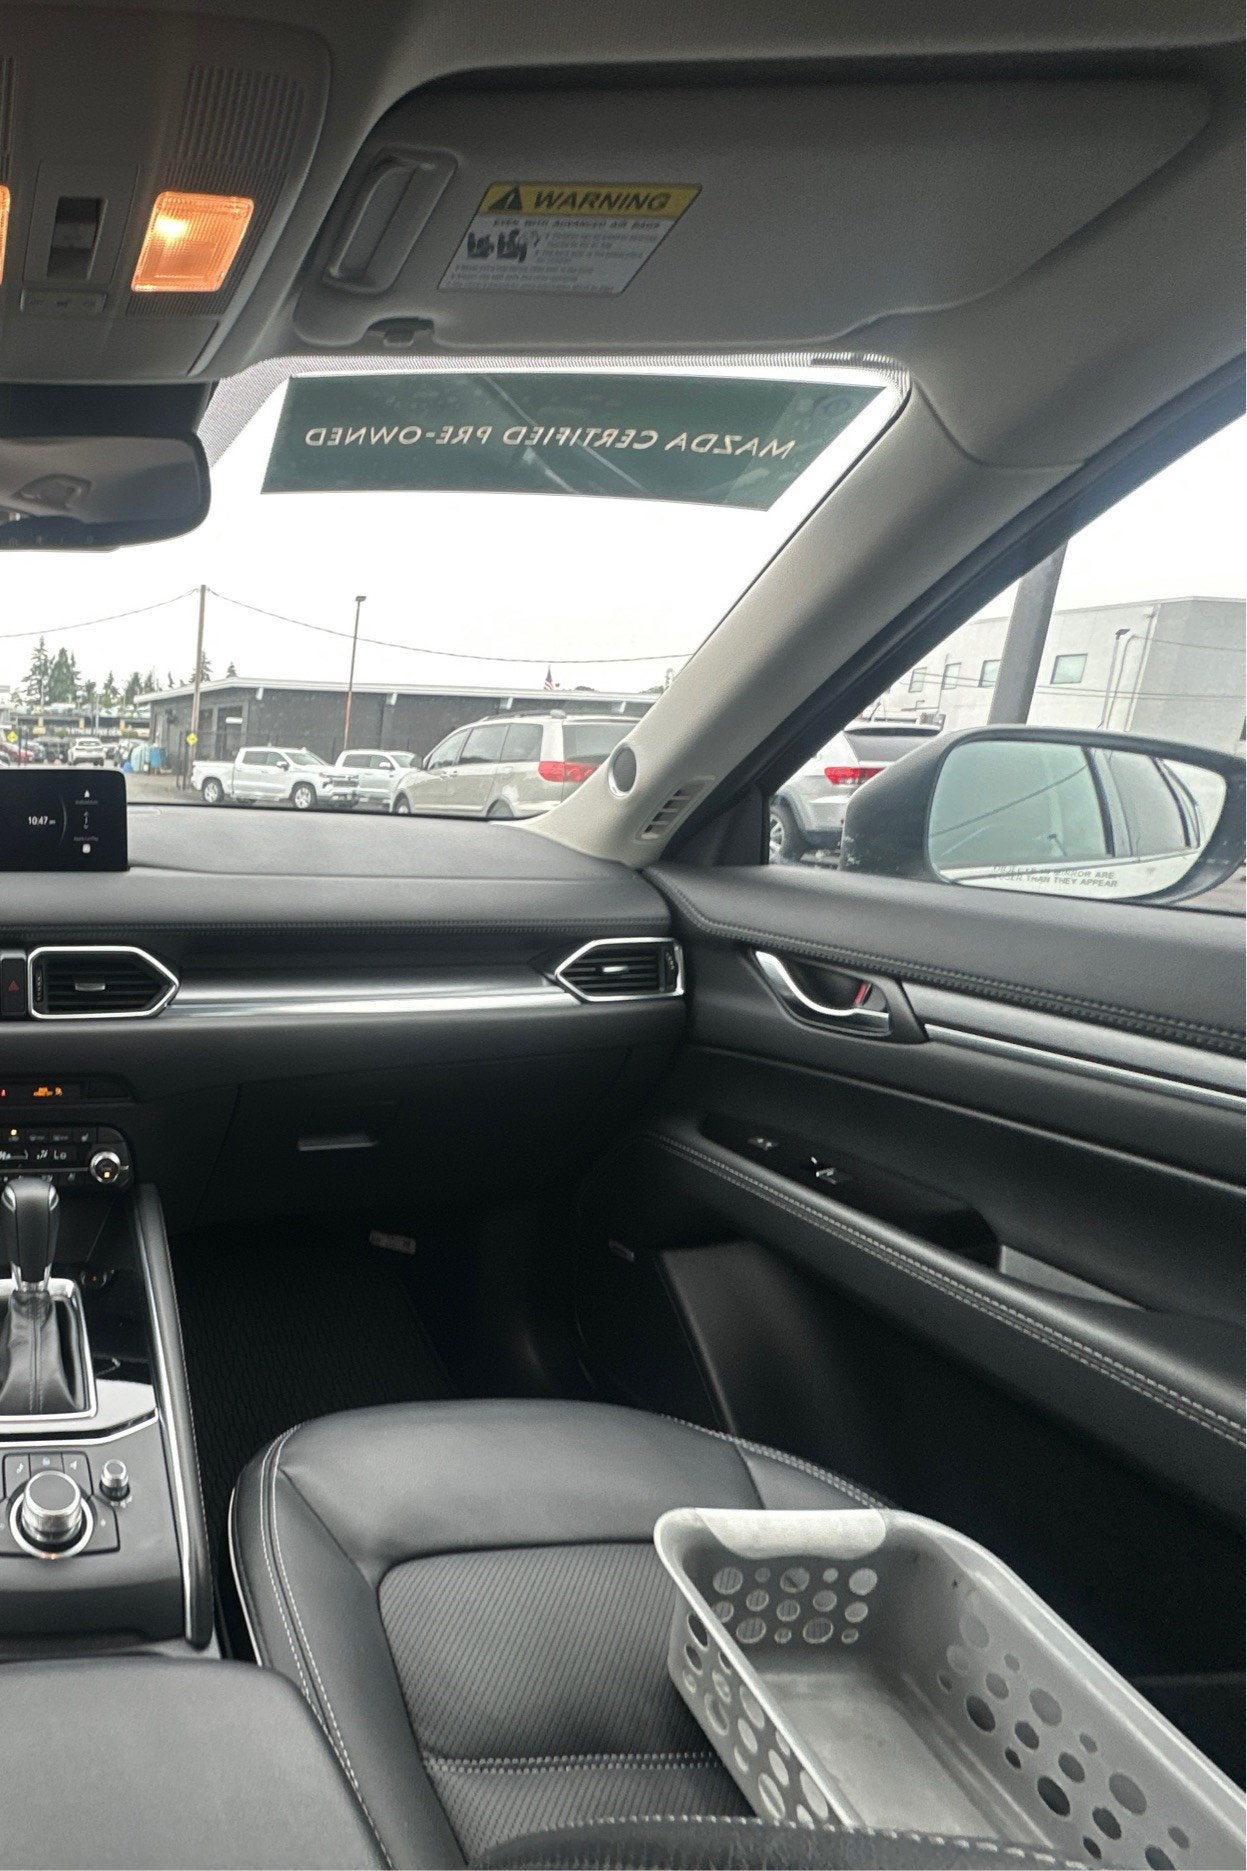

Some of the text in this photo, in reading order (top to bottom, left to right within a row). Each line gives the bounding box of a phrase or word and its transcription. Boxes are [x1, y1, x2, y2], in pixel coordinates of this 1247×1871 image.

[533, 190, 672, 211] WARNING
[28, 815, 49, 826] 10:47
[1026, 875, 1051, 883] THAN
[1054, 877, 1078, 885] THEY
[1080, 878, 1118, 888] APPEAR
[1095, 871, 1115, 880] ARE
